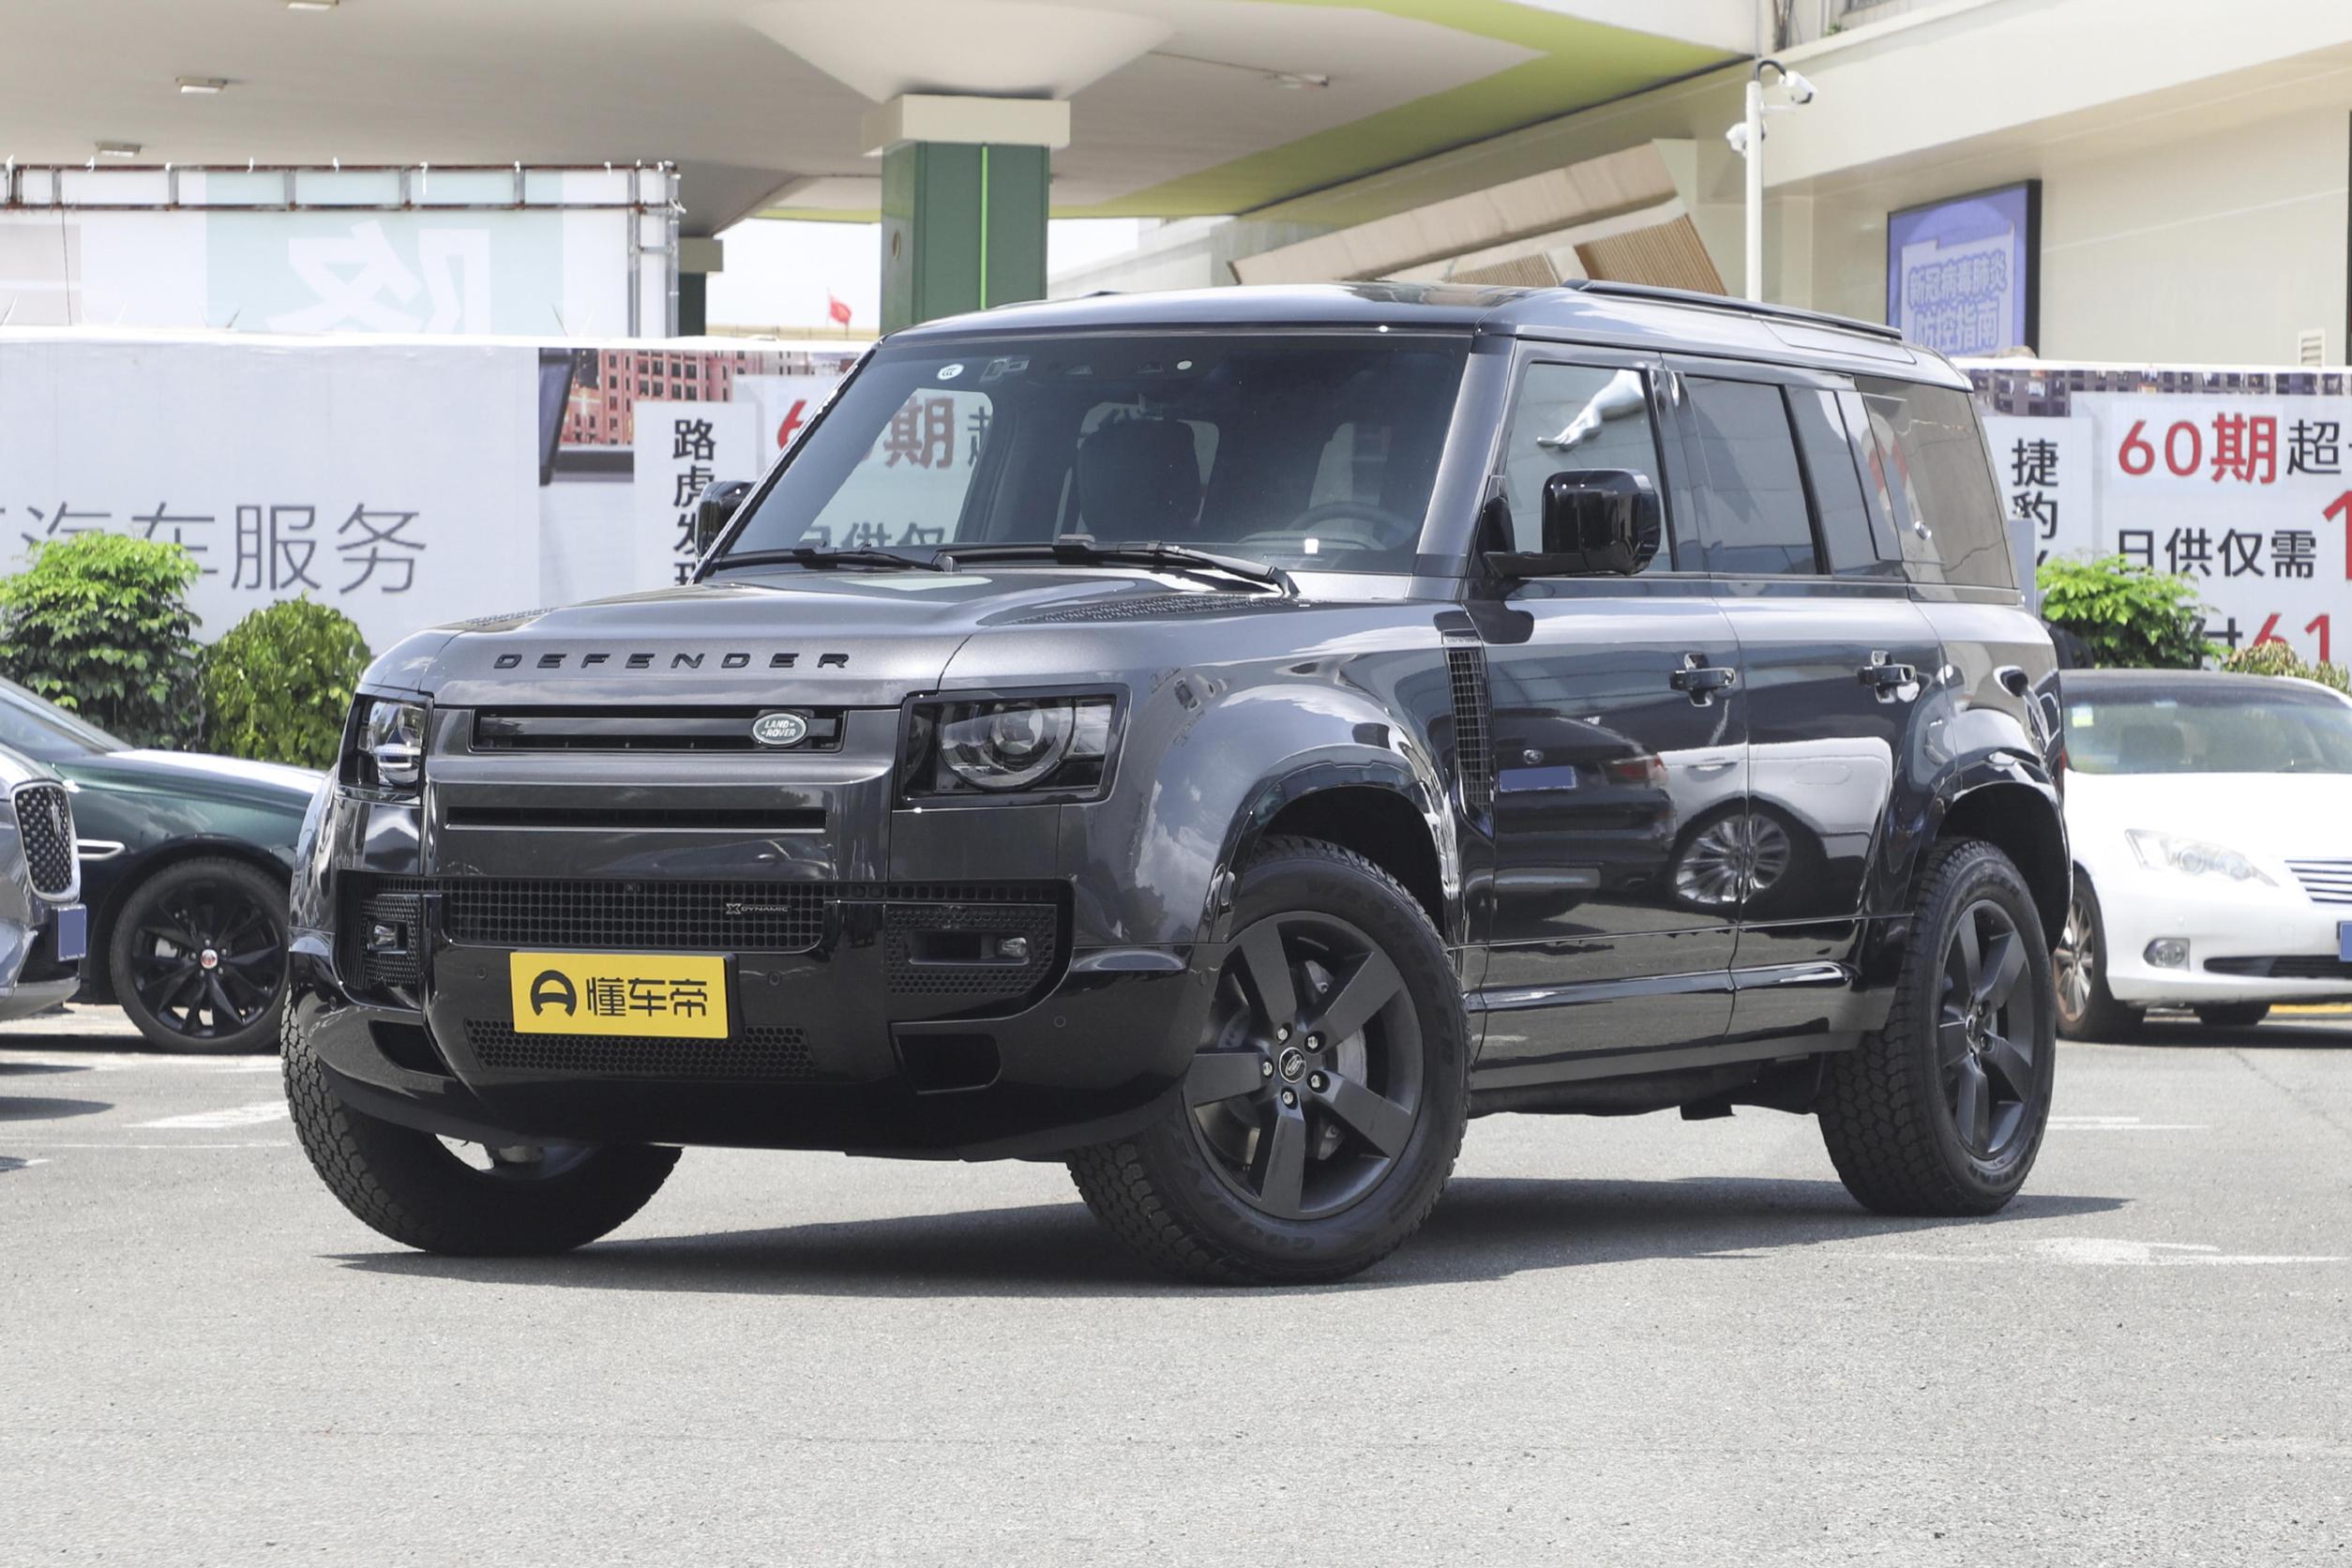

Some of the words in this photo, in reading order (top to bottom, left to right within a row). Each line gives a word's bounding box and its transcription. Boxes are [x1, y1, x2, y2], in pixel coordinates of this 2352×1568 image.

[1910, 252, 2005, 308] 新冠病毒肺炎
[1915, 299, 1998, 353] 防控指南
[2118, 413, 2352, 484] 60期超
[494, 653, 850, 669] DEFENDER
[765, 720, 790, 729] LAND
[765, 729, 796, 737] ROVER
[586, 976, 708, 1018] 懂车帝
